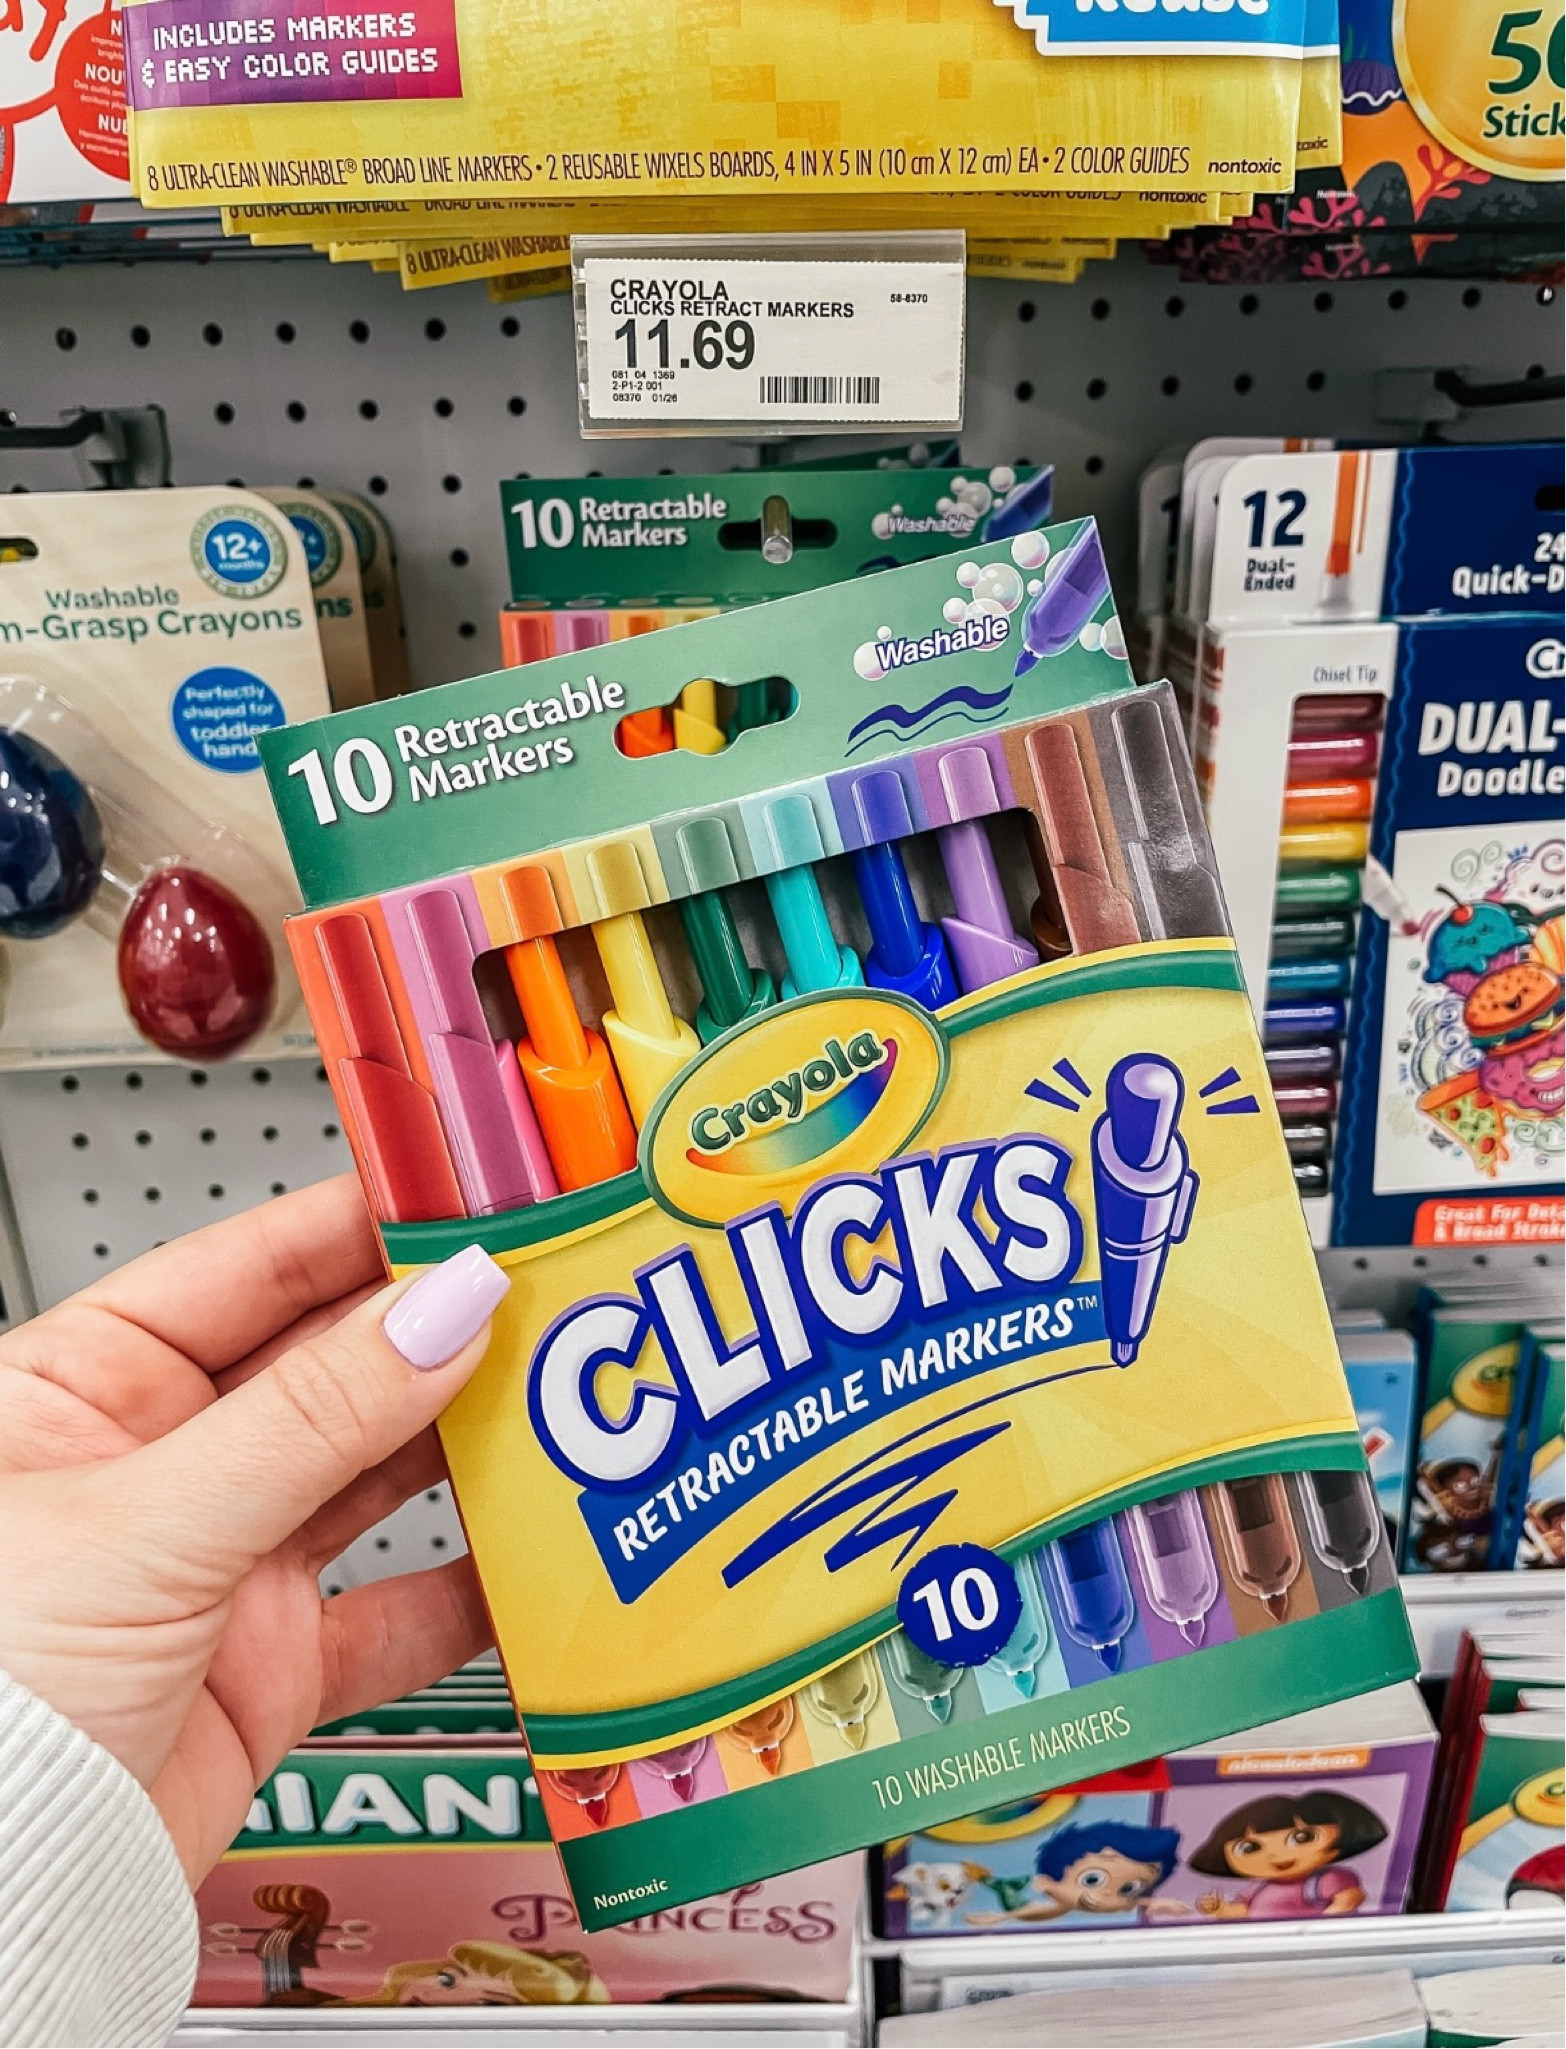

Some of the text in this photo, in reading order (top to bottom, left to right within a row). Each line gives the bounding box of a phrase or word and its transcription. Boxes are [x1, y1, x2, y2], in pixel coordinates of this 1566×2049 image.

[153, 18, 277, 52] INCLUDES
[286, 12, 417, 44] MARKERS
[164, 55, 232, 84] EASY
[243, 51, 331, 80] COLOR
[341, 47, 439, 76] GUIDES
[147, 167, 159, 192] 8
[161, 163, 261, 191] ULTRA-CLEAN
[363, 157, 417, 186] BROAD
[421, 156, 453, 184] LINE
[457, 153, 532, 183] MARKERS
[546, 154, 559, 182] 2
[562, 151, 641, 180] REUSABLE
[645, 151, 705, 180] WIXELS
[709, 149, 780, 182] BOARDS,
[784, 149, 795, 176] 4
[801, 149, 817, 177] IN
[821, 149, 835, 176] X
[839, 149, 850, 176] 5
[855, 149, 872, 176] IN
[878, 147, 906, 179] (10
[911, 153, 935, 175] cm
[939, 148, 952, 175] X
[959, 148, 976, 175] 12
[983, 147, 1012, 176] cm)
[1019, 147, 1039, 174] EA
[1053, 147, 1065, 174] 2
[1070, 147, 1124, 174] COLOR
[1129, 146, 1190, 174] GUIDES
[1207, 157, 1282, 175] nontoxic
[405, 253, 417, 274] 8
[418, 240, 501, 272] ULTRA-CLEAN
[609, 279, 729, 301] CRAYOLA
[609, 301, 854, 318] CLICKS RETRACT MARKERS
[614, 319, 755, 370] 11.69
[634, 370, 646, 379] 04
[510, 493, 727, 549] 10 Retractable
[581, 523, 688, 548] Markers
[887, 513, 976, 534] Washable
[1242, 489, 1308, 549] 12
[211, 531, 263, 561] 12+
[1243, 574, 1296, 592] Ended
[1246, 558, 1296, 574] Dual-
[44, 583, 180, 611] Washable
[157, 604, 302, 640] Crayons
[875, 615, 1009, 671] Washable
[184, 683, 266, 702] Perfectly
[1313, 664, 1378, 685] Chisel Tip
[182, 703, 274, 721] shaped for
[286, 674, 627, 826] 10 Retractable
[408, 736, 575, 804] Markers
[690, 1028, 884, 1151] Crayola
[534, 1140, 1076, 1488] CLICKS
[612, 1369, 871, 1563] RETRACTABLE
[912, 1566, 1000, 1643] 10
[871, 1706, 1132, 1810] 10 WASHABLE MARKERS
[246, 1771, 539, 1837] IAN
[593, 1877, 669, 1911] Nontoxic
[491, 1892, 838, 1945] PNCESS
